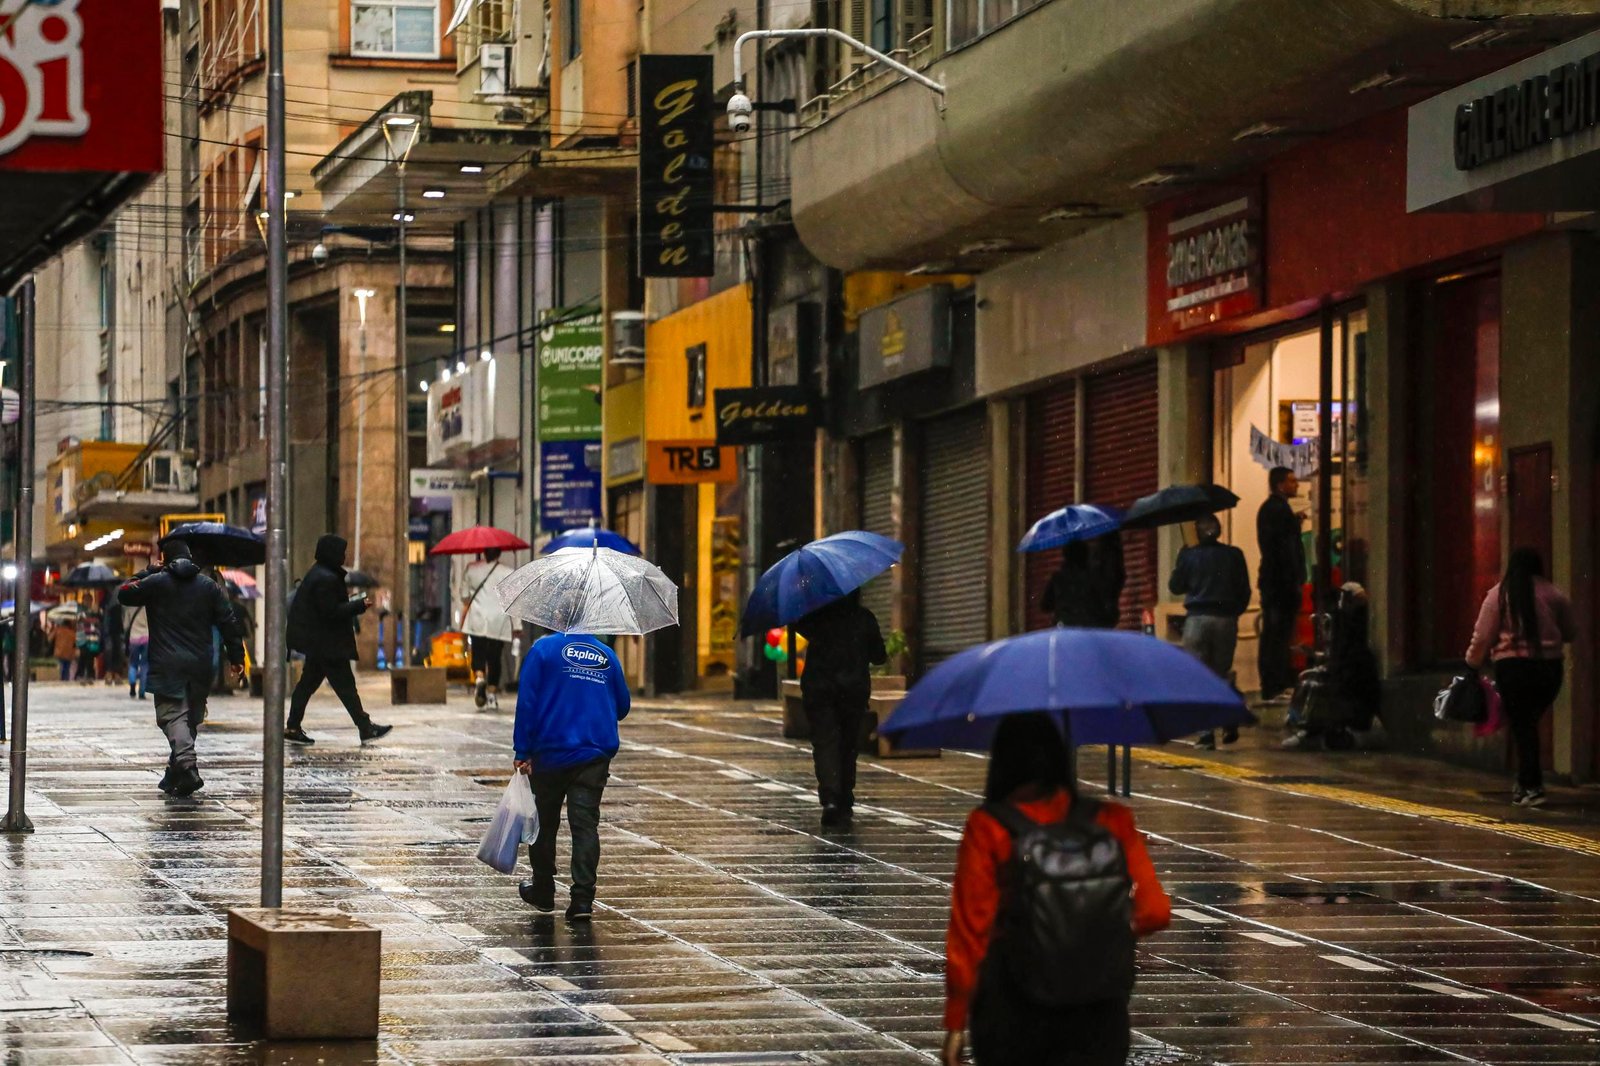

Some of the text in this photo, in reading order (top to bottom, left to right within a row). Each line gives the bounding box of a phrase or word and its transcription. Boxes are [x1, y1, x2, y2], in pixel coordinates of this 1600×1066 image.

[1454, 74, 1550, 171] GALERIA
[654, 79, 698, 266] Golden
[1167, 219, 1248, 288] americanas
[551, 345, 603, 364] UNICORP
[720, 400, 808, 427] Golden
[567, 647, 608, 665] Explorer
